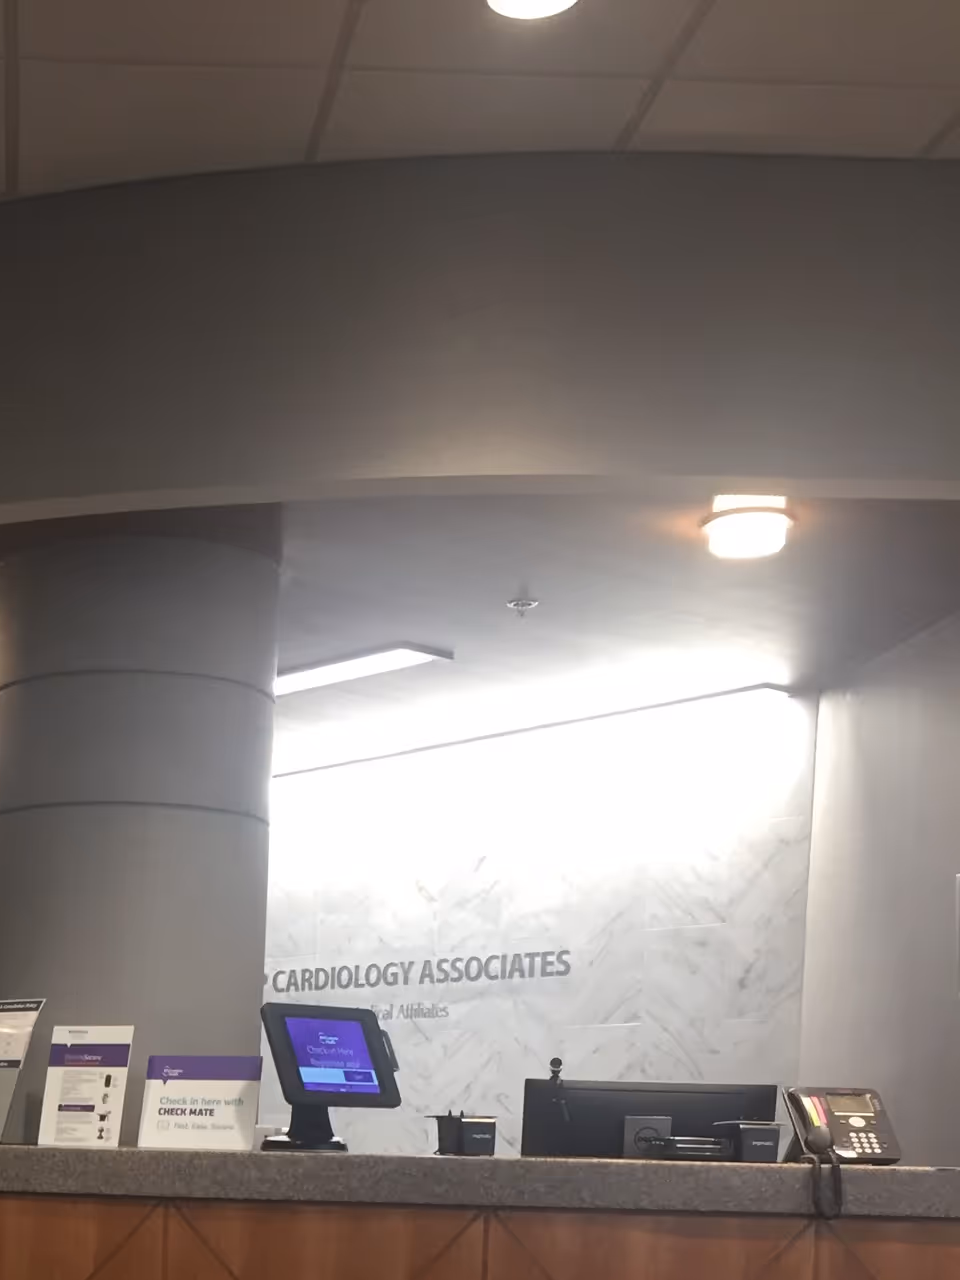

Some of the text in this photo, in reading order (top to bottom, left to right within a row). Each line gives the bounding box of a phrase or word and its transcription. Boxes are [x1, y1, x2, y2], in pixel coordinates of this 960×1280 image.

[272, 961, 415, 993] CARDIOLOGY
[419, 949, 571, 984] ASSOCIATES
[159, 1096, 245, 1107] Check in here with
[158, 1107, 215, 1117] CHECK MATE
